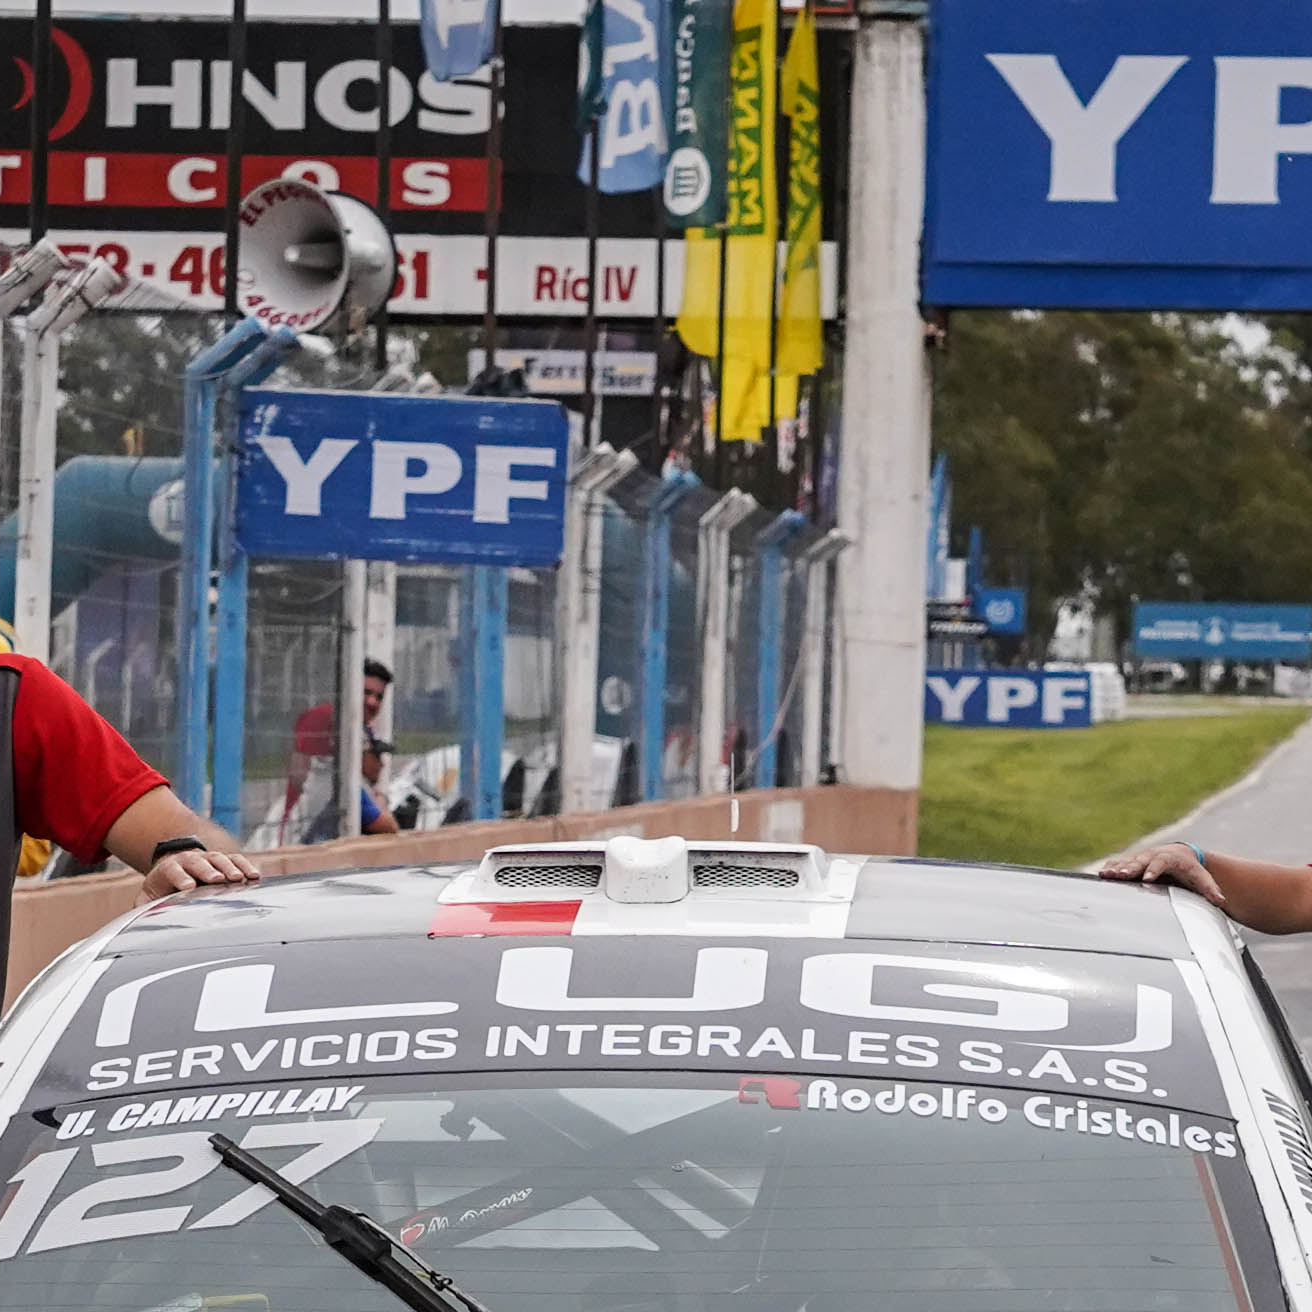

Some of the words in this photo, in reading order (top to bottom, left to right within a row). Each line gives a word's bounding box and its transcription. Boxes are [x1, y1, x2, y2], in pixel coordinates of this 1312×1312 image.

[105, 57, 504, 135] HNOS
[603, 267, 637, 301] IV
[256, 435, 556, 524] YPF
[927, 676, 1090, 724] YPF
[86, 1025, 459, 1092] SERVICIOS
[485, 1023, 940, 1069] INTEGRALES
[959, 1040, 1168, 1098] S.A.S.
[56, 1109, 95, 1142] U.
[107, 1086, 366, 1134] CAMPILLAY
[807, 1079, 1008, 1125] Rodolfo
[1023, 1094, 1239, 1158] Cristales
